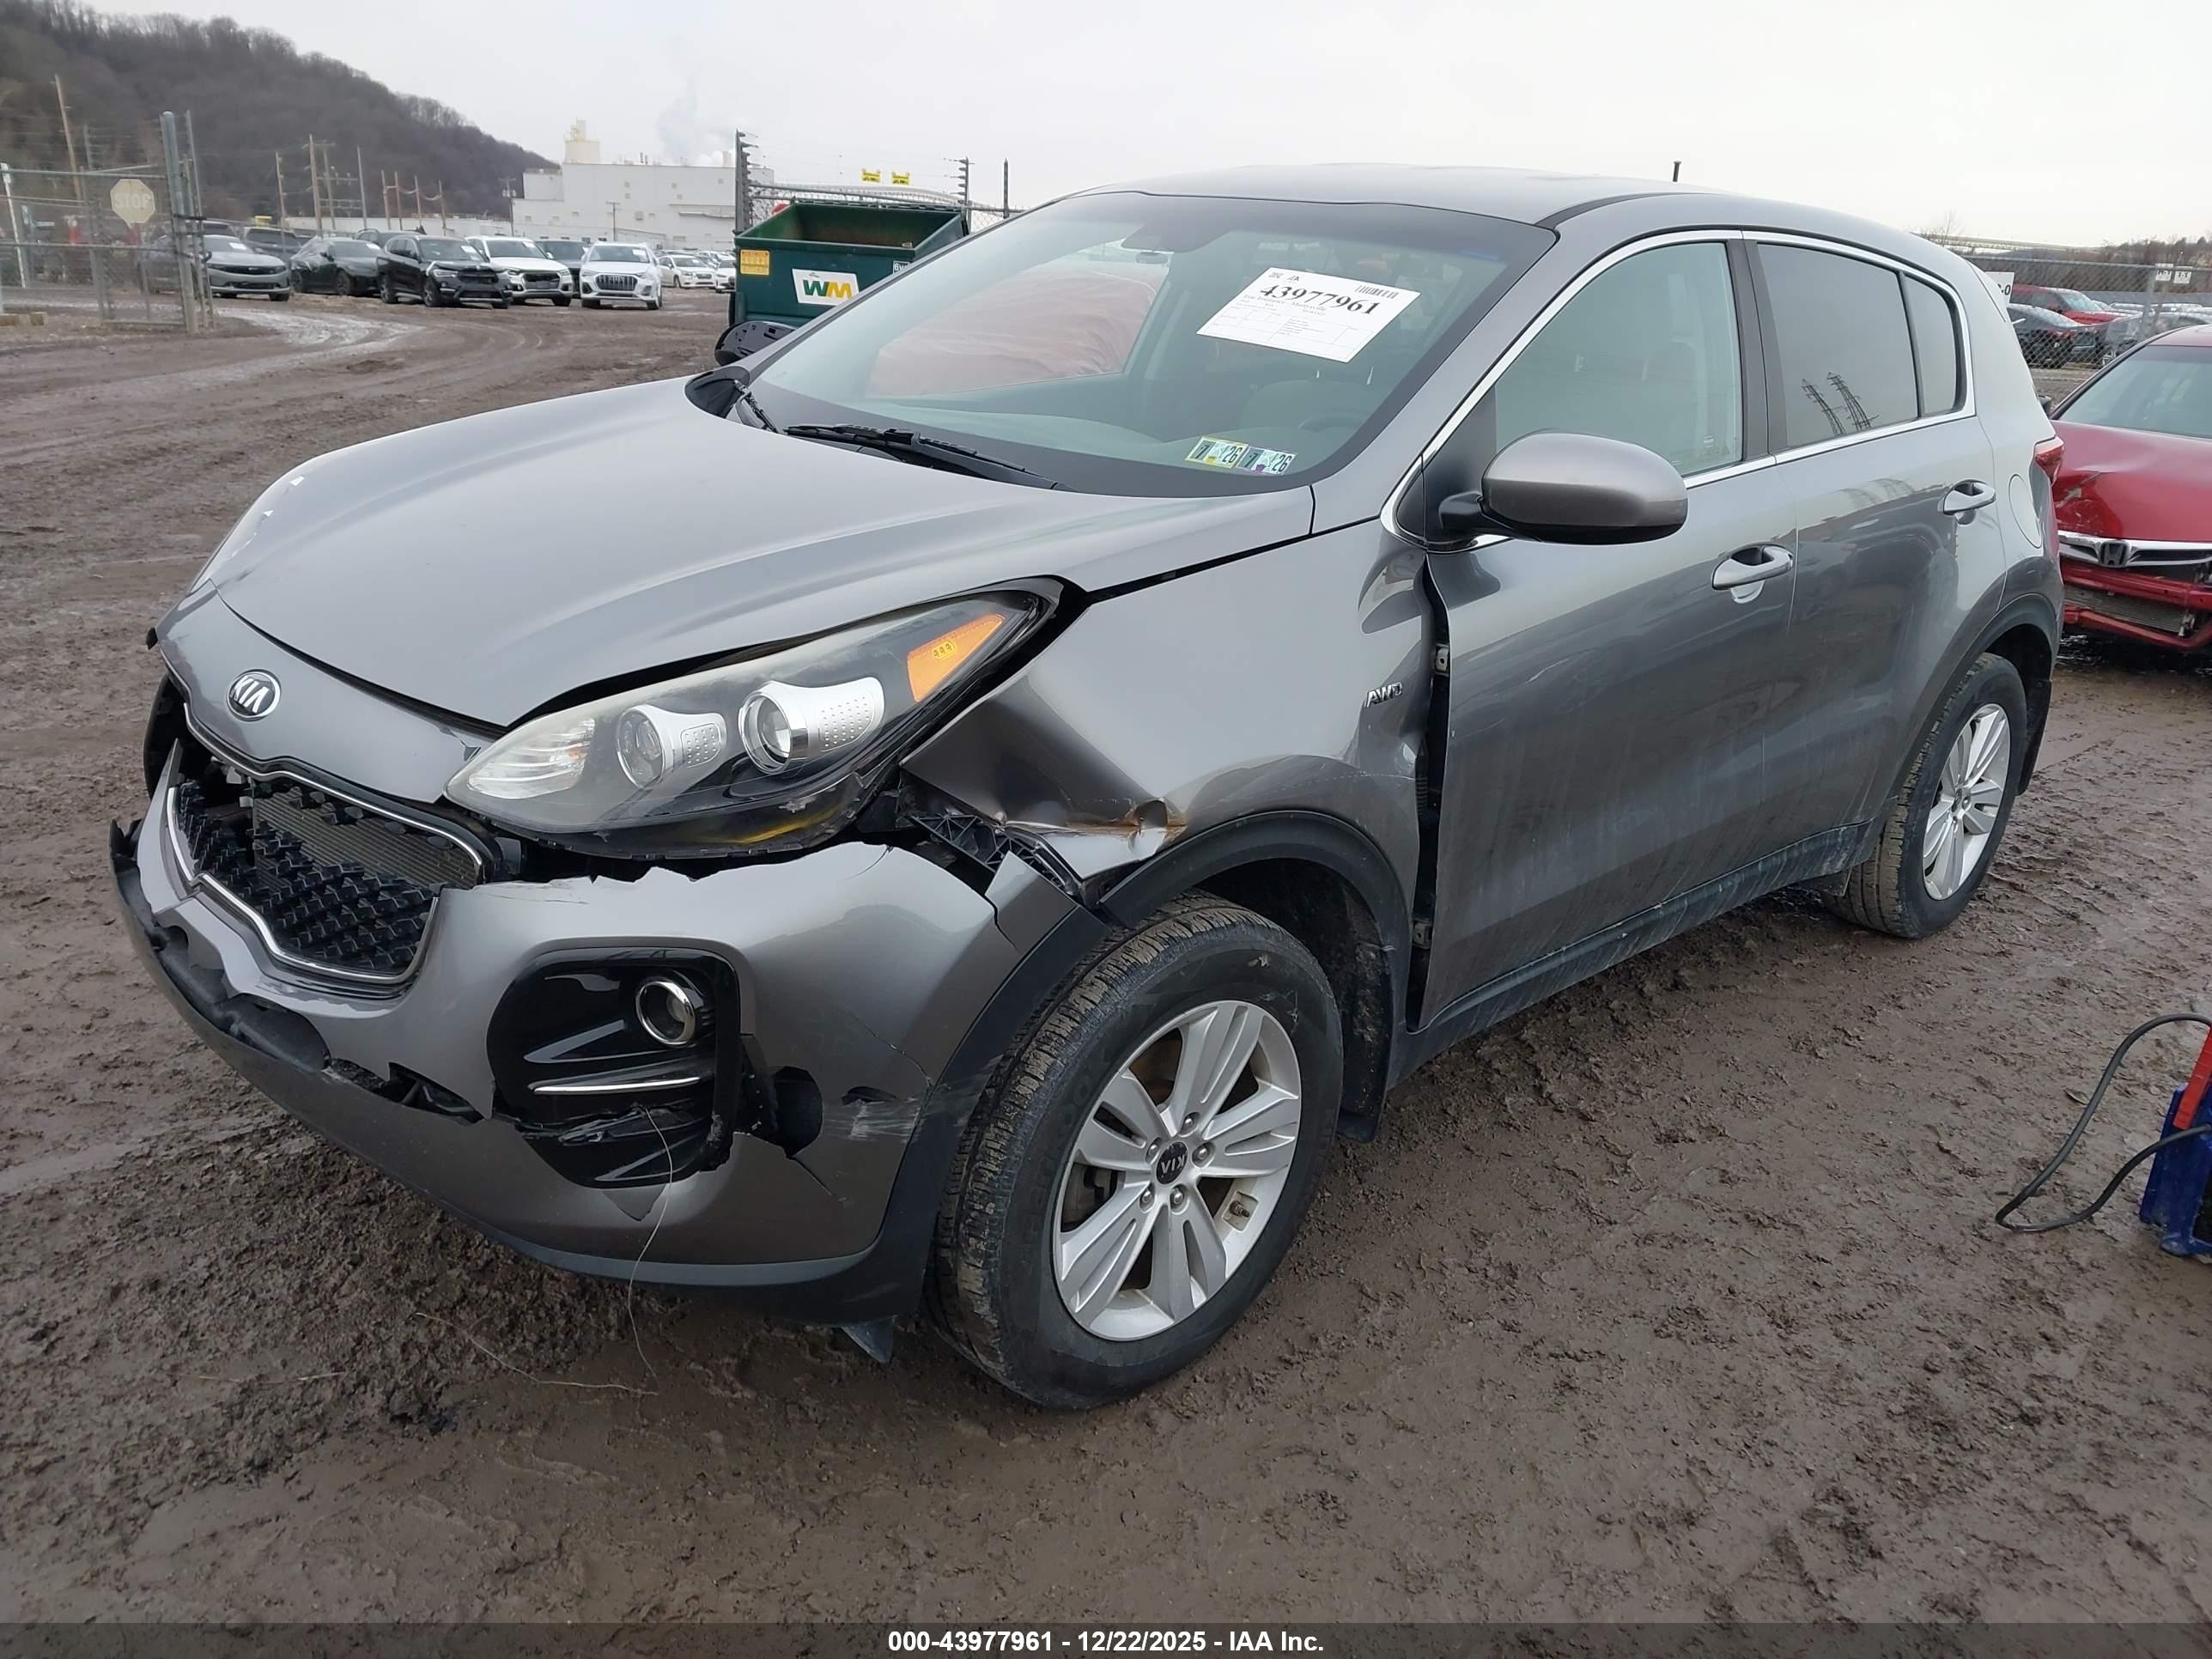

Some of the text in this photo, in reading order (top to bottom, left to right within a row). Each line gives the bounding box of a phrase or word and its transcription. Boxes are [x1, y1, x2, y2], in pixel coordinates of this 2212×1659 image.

[113, 192, 152, 209] STOP
[802, 279, 853, 300] WM
[1259, 284, 1380, 314] 43977961
[1194, 445, 1243, 464] 7 26
[1244, 453, 1292, 472] 7 26
[229, 675, 270, 714] KIA
[1366, 682, 1403, 708] AWD
[1161, 1154, 1185, 1174] KIA
